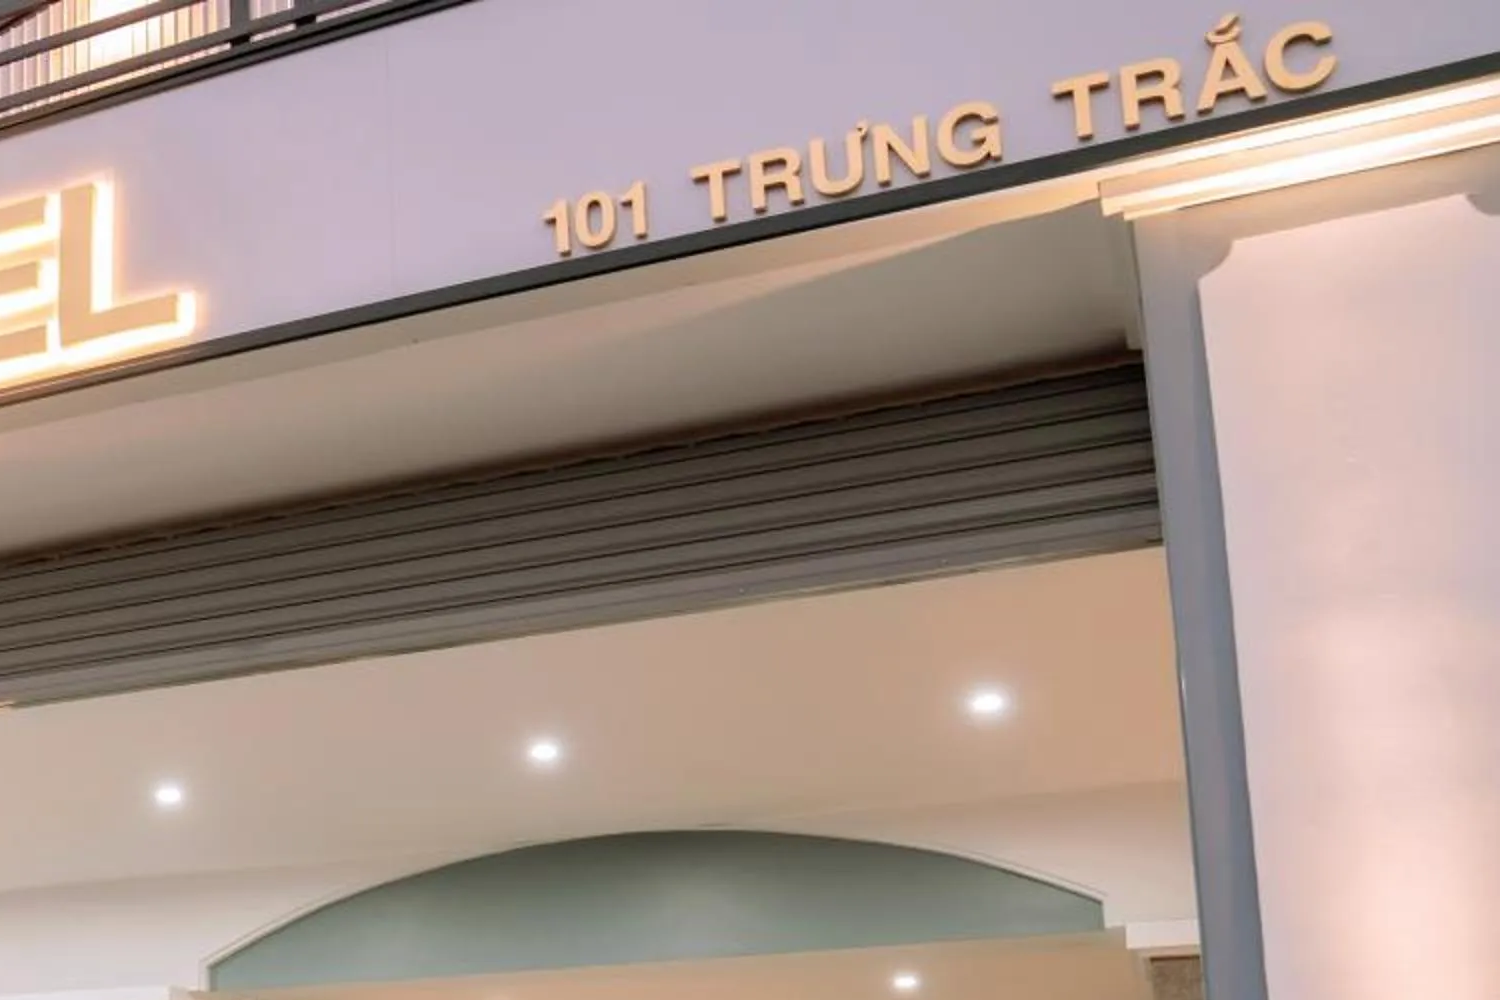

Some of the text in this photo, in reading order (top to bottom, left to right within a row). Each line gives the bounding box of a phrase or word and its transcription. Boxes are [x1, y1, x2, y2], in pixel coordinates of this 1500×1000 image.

[542, 13, 1338, 257] 101 TRƯNG TRẮC
